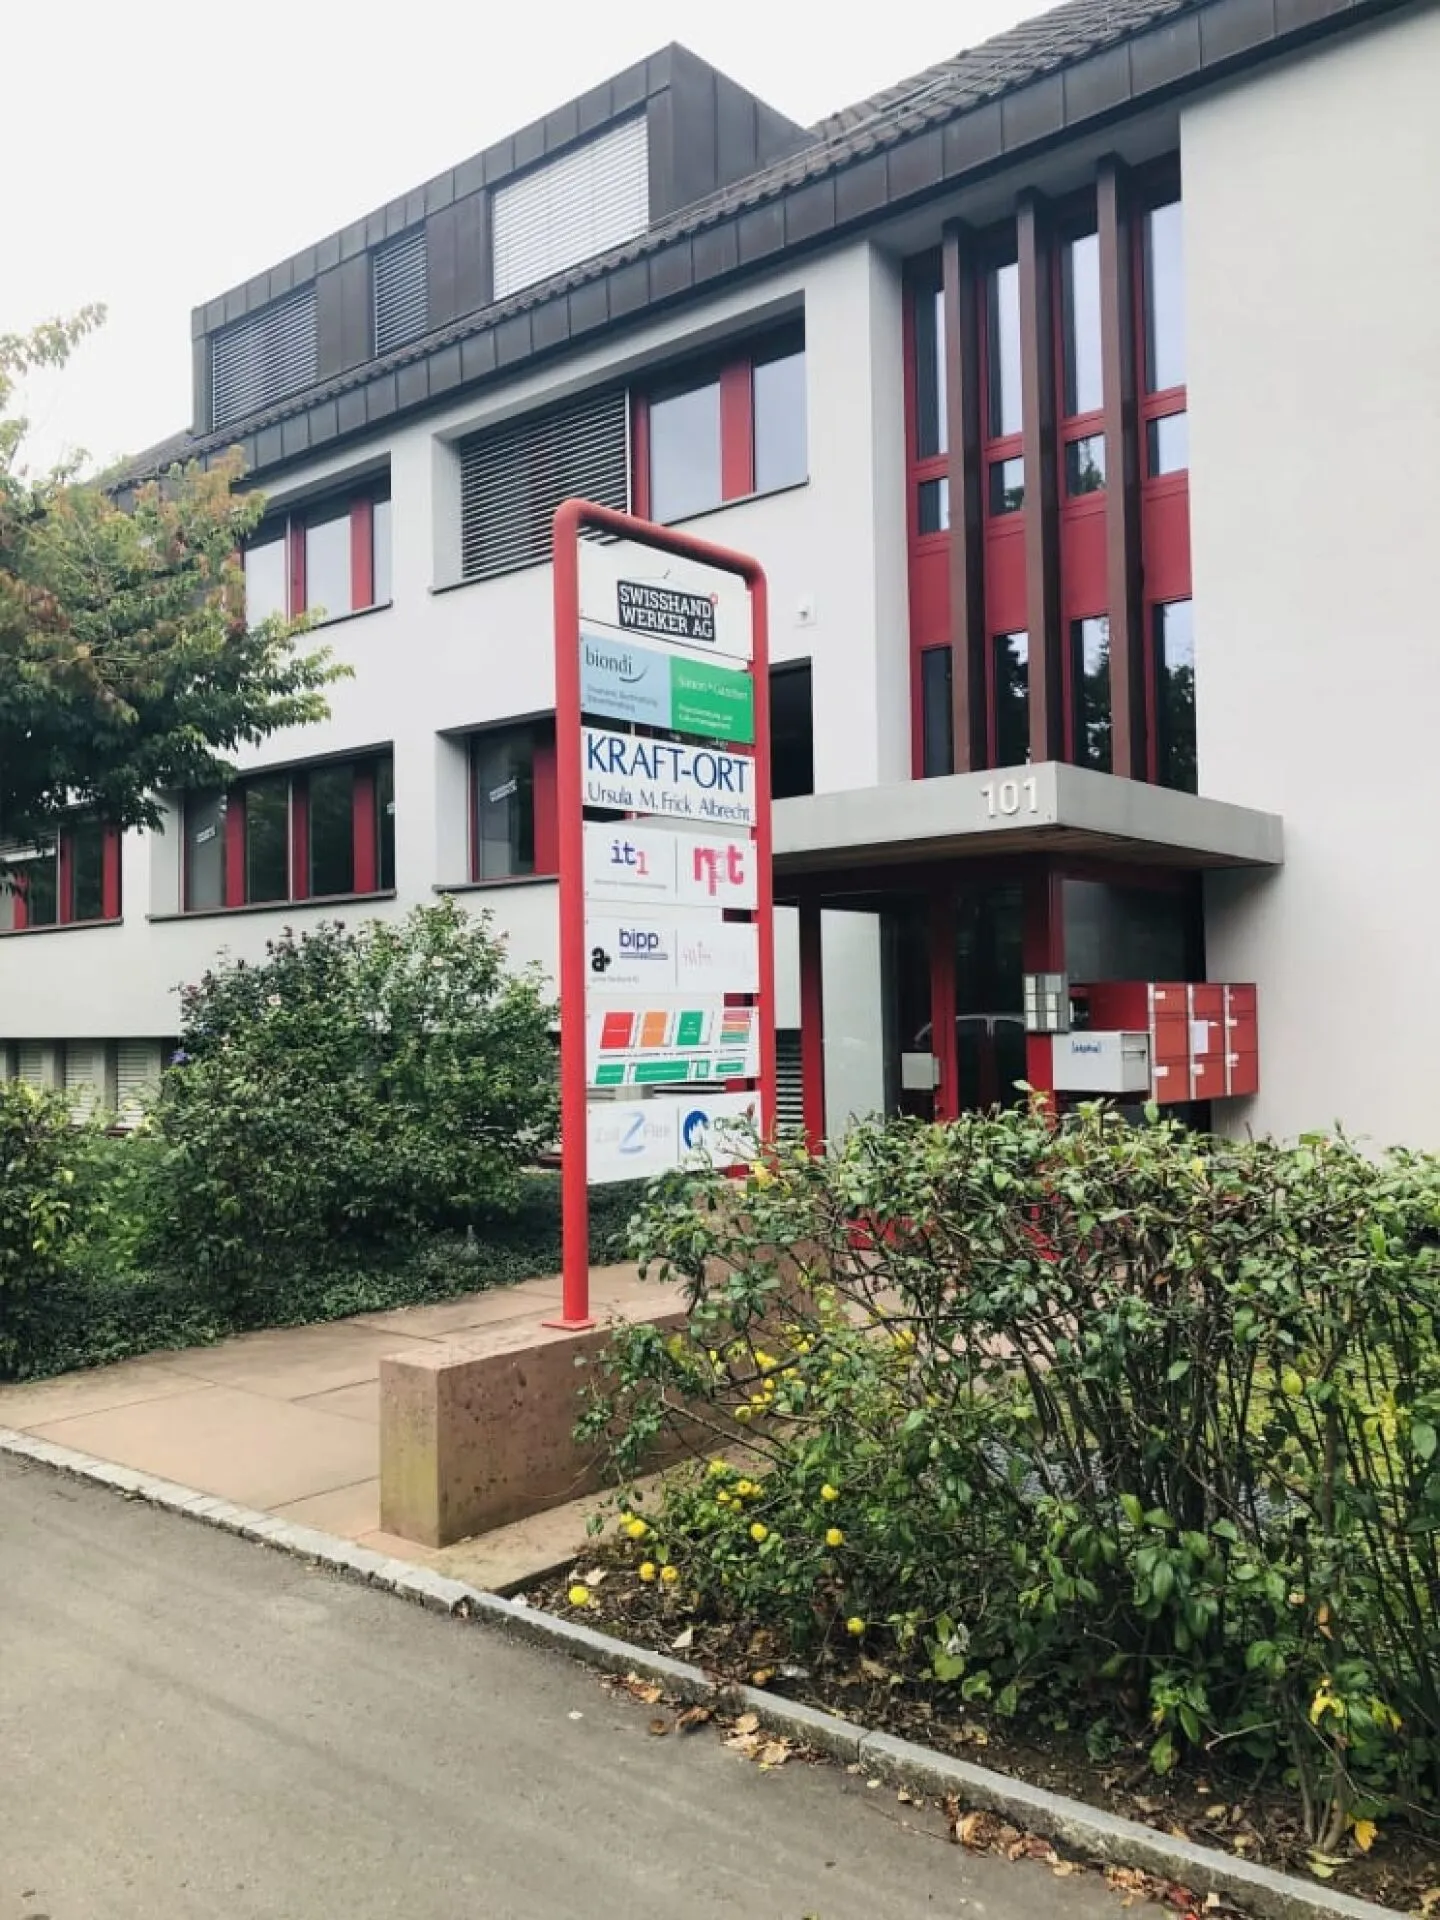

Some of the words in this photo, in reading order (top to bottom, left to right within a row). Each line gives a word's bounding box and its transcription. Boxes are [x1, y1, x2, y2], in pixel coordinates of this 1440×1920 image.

[619, 583, 713, 619] SWISSHAND
[620, 604, 689, 634] WERKER
[692, 620, 713, 638] AG
[585, 644, 633, 676] biondi
[587, 733, 750, 793] KRAFT-ORT
[588, 782, 632, 806] Ursula
[661, 790, 692, 814] Frick
[700, 797, 751, 823] Albrecht
[981, 777, 1037, 817] 101
[619, 928, 660, 950] bipp
